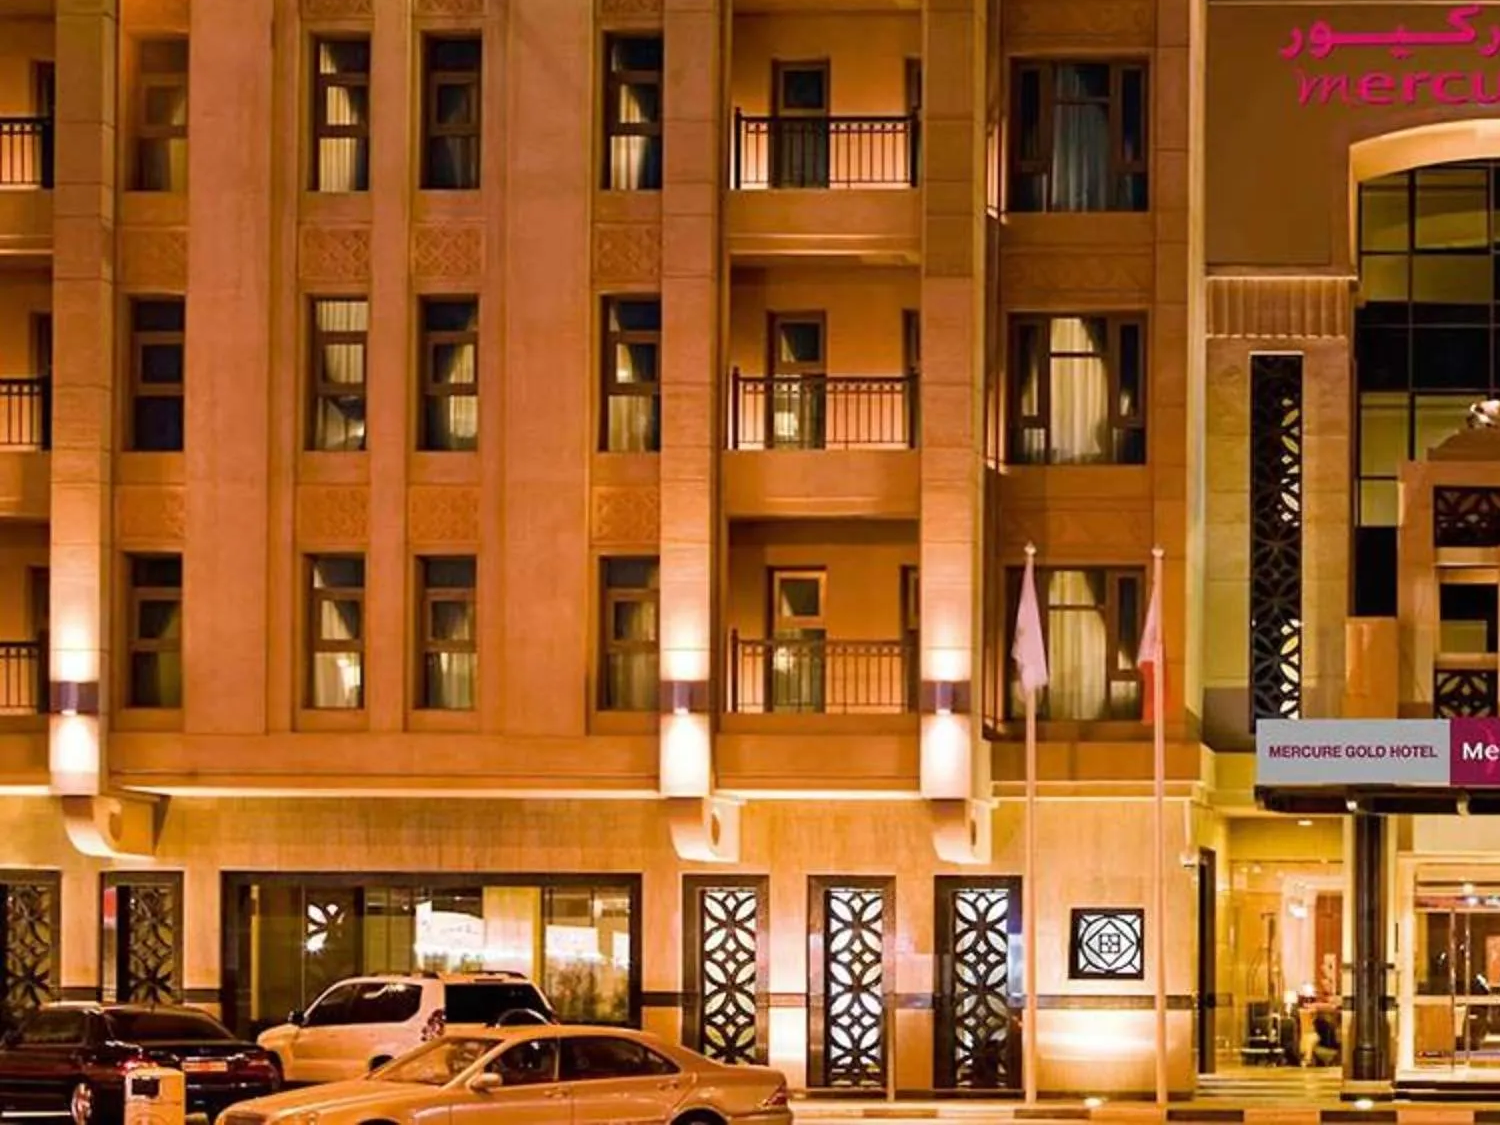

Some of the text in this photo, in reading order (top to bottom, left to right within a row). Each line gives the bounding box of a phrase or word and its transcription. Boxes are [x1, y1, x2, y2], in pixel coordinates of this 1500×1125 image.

[1269, 745, 1438, 758] MERCURE GOLD HOTEL
